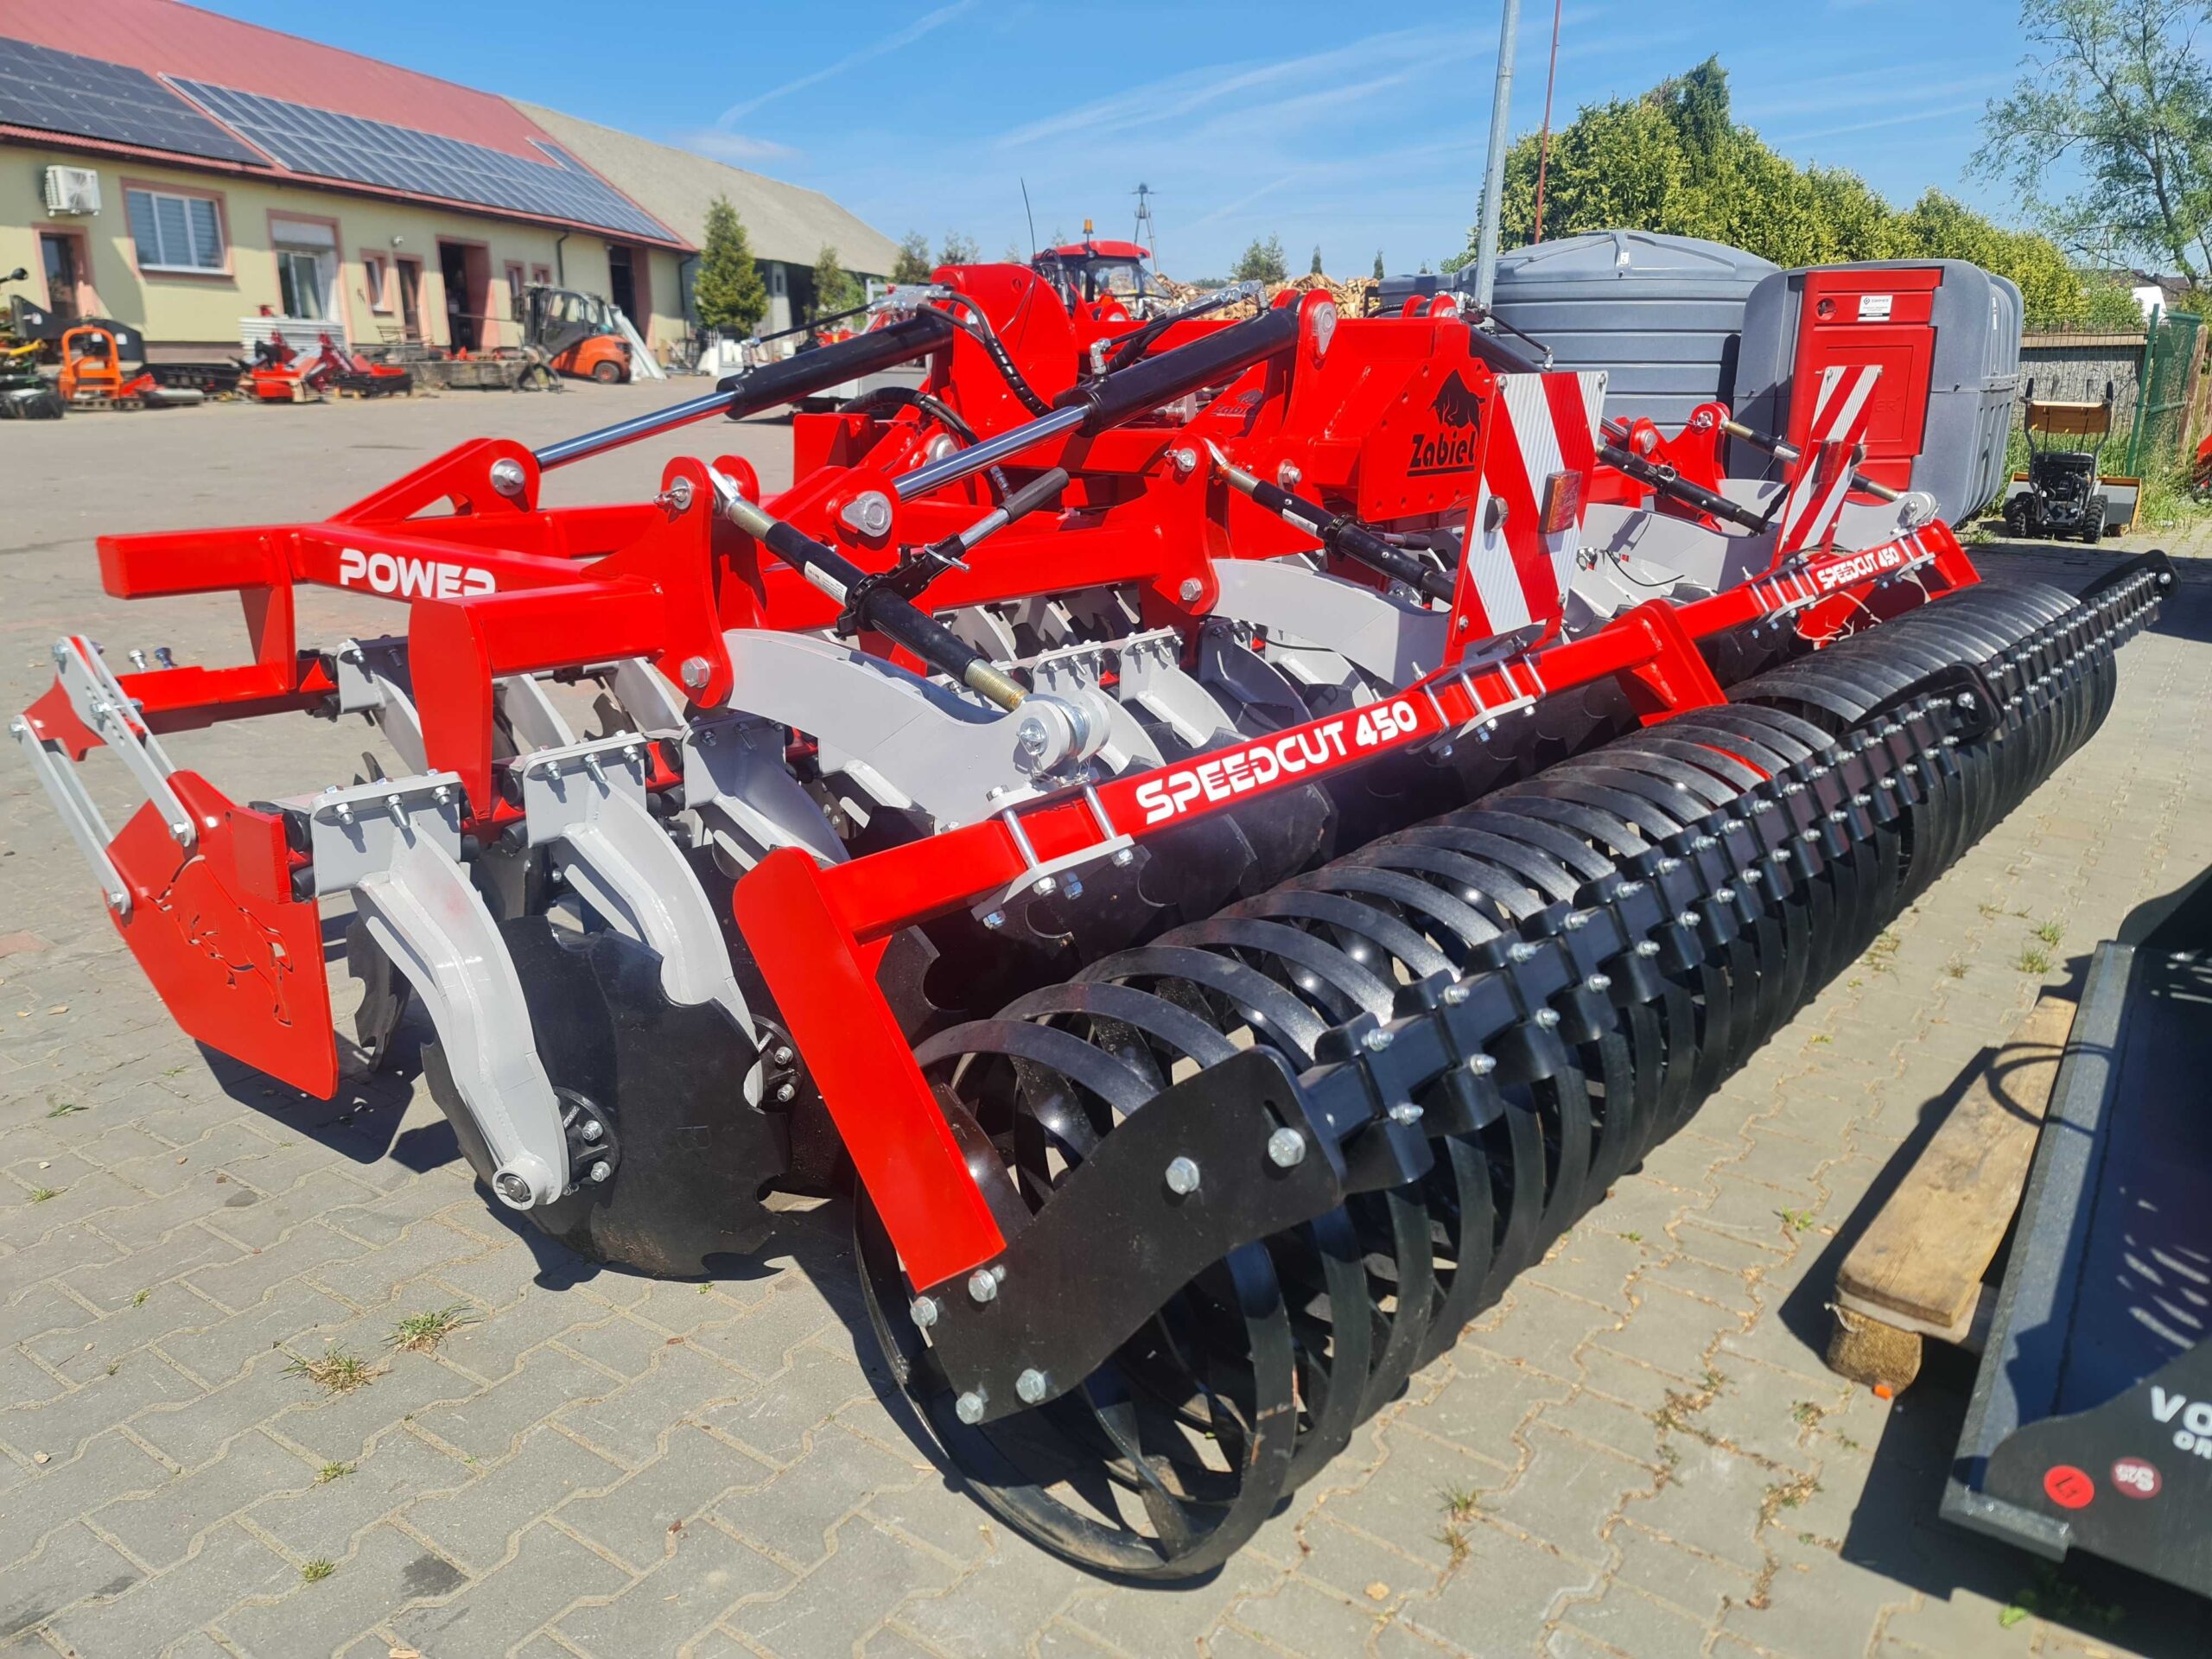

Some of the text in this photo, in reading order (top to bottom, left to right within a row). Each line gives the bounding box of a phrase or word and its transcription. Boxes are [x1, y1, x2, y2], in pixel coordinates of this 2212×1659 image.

[1409, 430, 1477, 468] Zabiel
[1816, 545, 1901, 591] SPEEDCUT 450
[1135, 700, 1418, 825] SPEEDCUT 450
